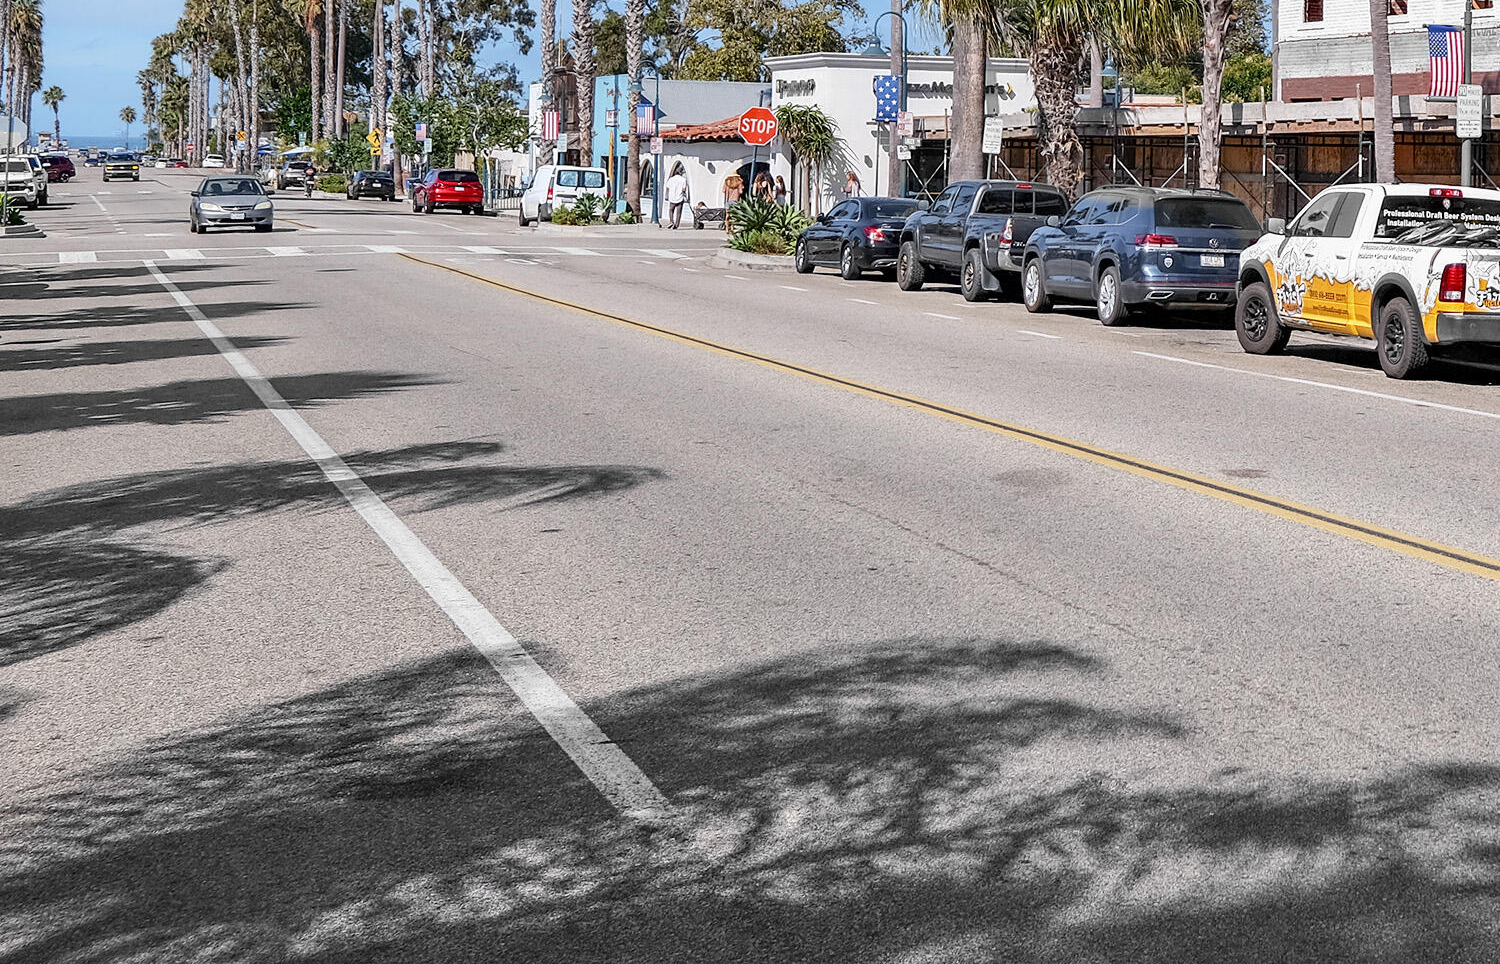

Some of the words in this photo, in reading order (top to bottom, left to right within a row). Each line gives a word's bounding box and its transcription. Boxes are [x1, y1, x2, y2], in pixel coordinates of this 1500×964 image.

[741, 118, 775, 134] STOP
[1383, 209, 1425, 218] Professional
[1426, 210, 1442, 219] Draft
[1444, 212, 1459, 220] Beer
[1460, 212, 1485, 222] System
[1387, 218, 1424, 227] Installation
